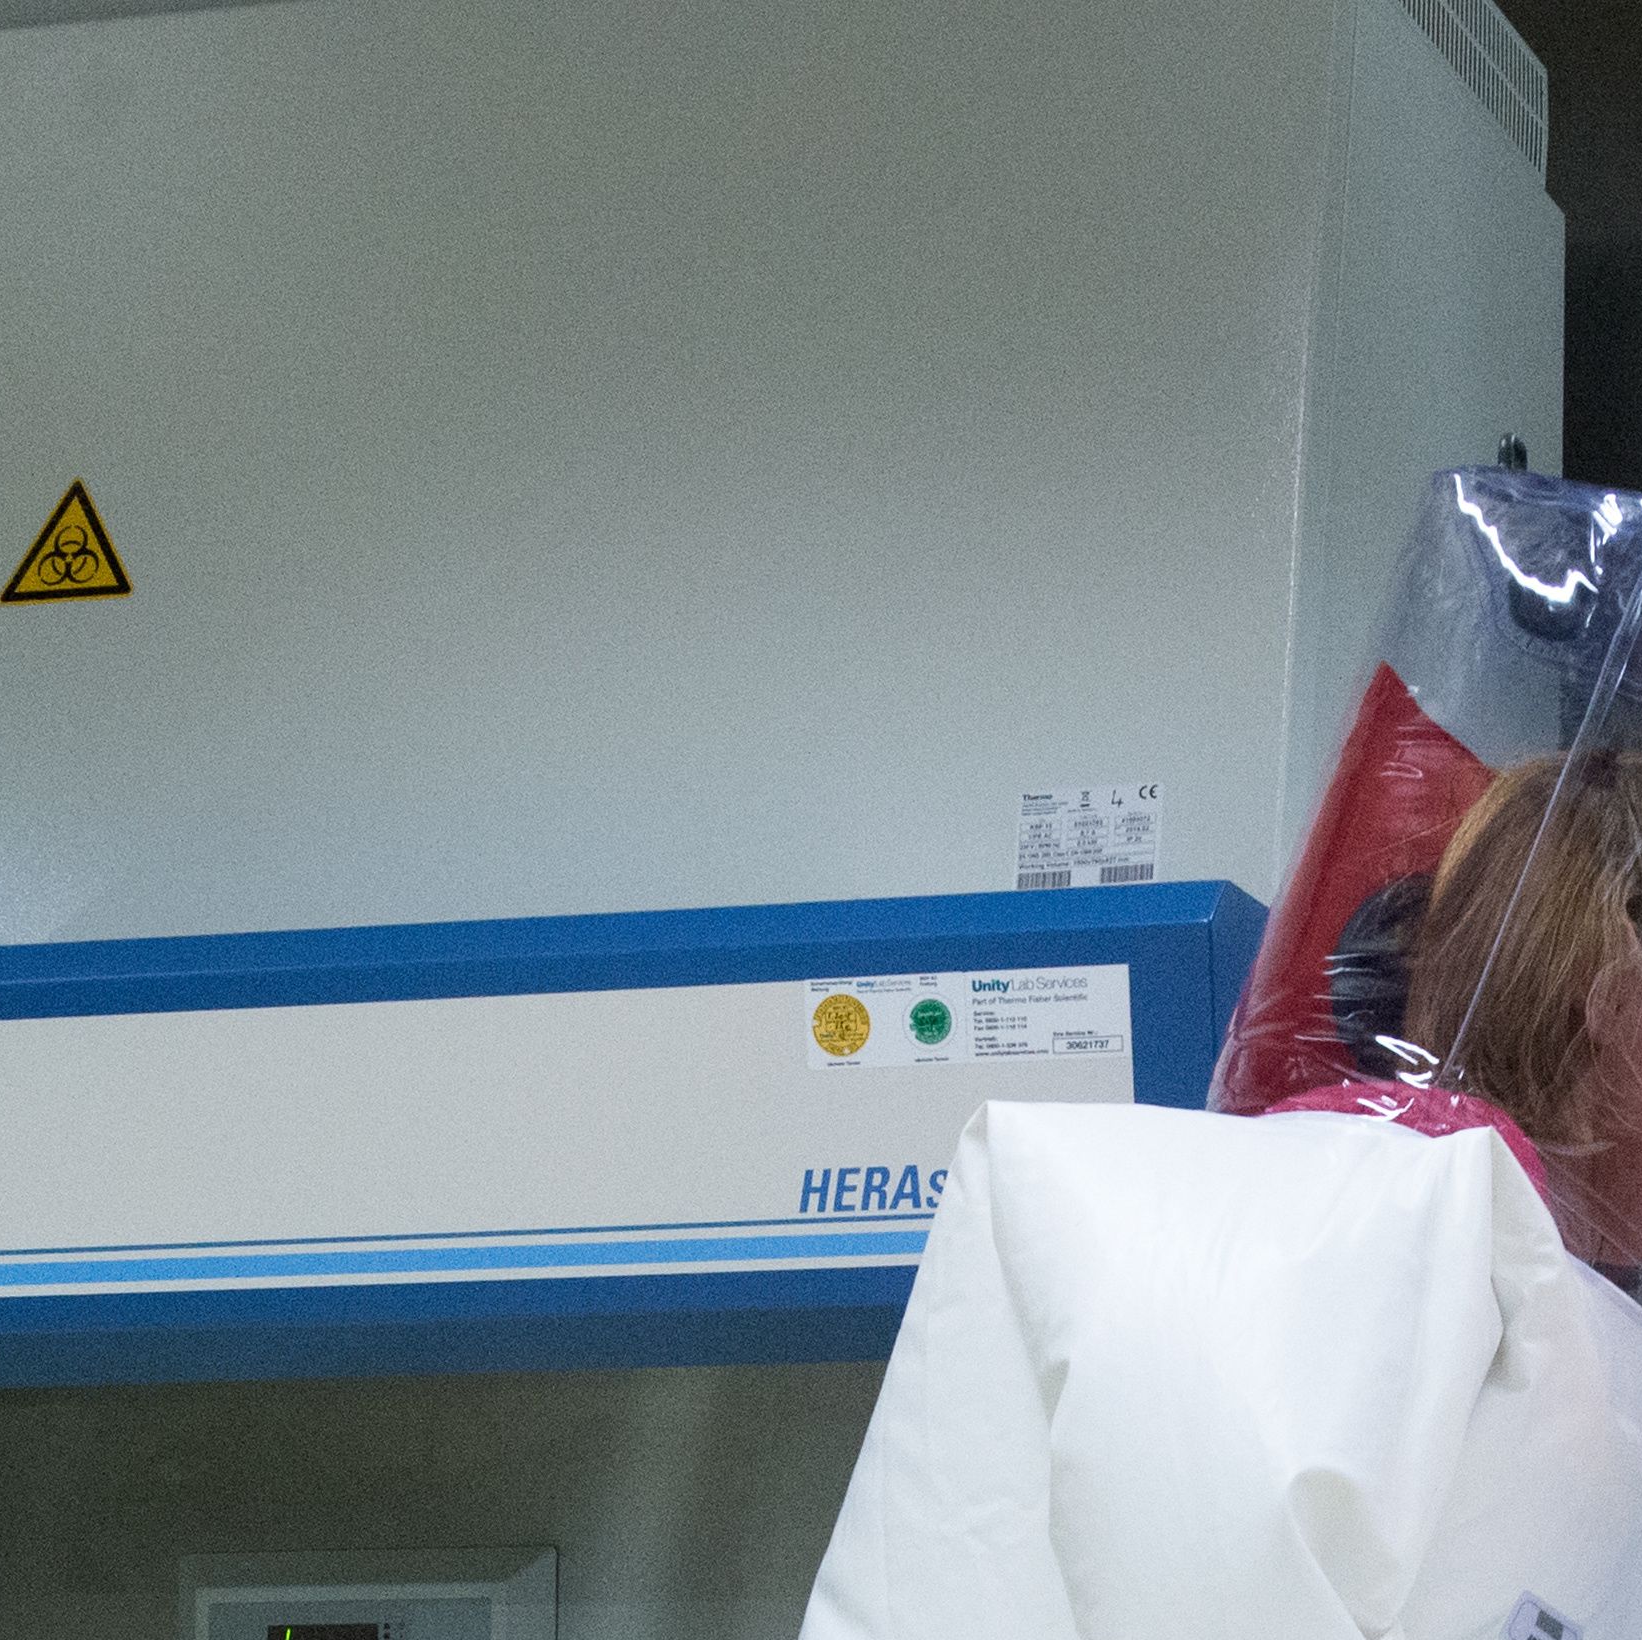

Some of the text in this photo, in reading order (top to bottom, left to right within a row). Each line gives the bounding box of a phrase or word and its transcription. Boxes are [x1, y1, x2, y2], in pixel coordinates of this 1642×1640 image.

[972, 976, 1088, 994] Unity Lab Services
[998, 997, 1027, 1005] Thermo
[1028, 995, 1051, 1003] Fisher
[1066, 1040, 1110, 1050] 30621737
[799, 1164, 948, 1213] HERAS
